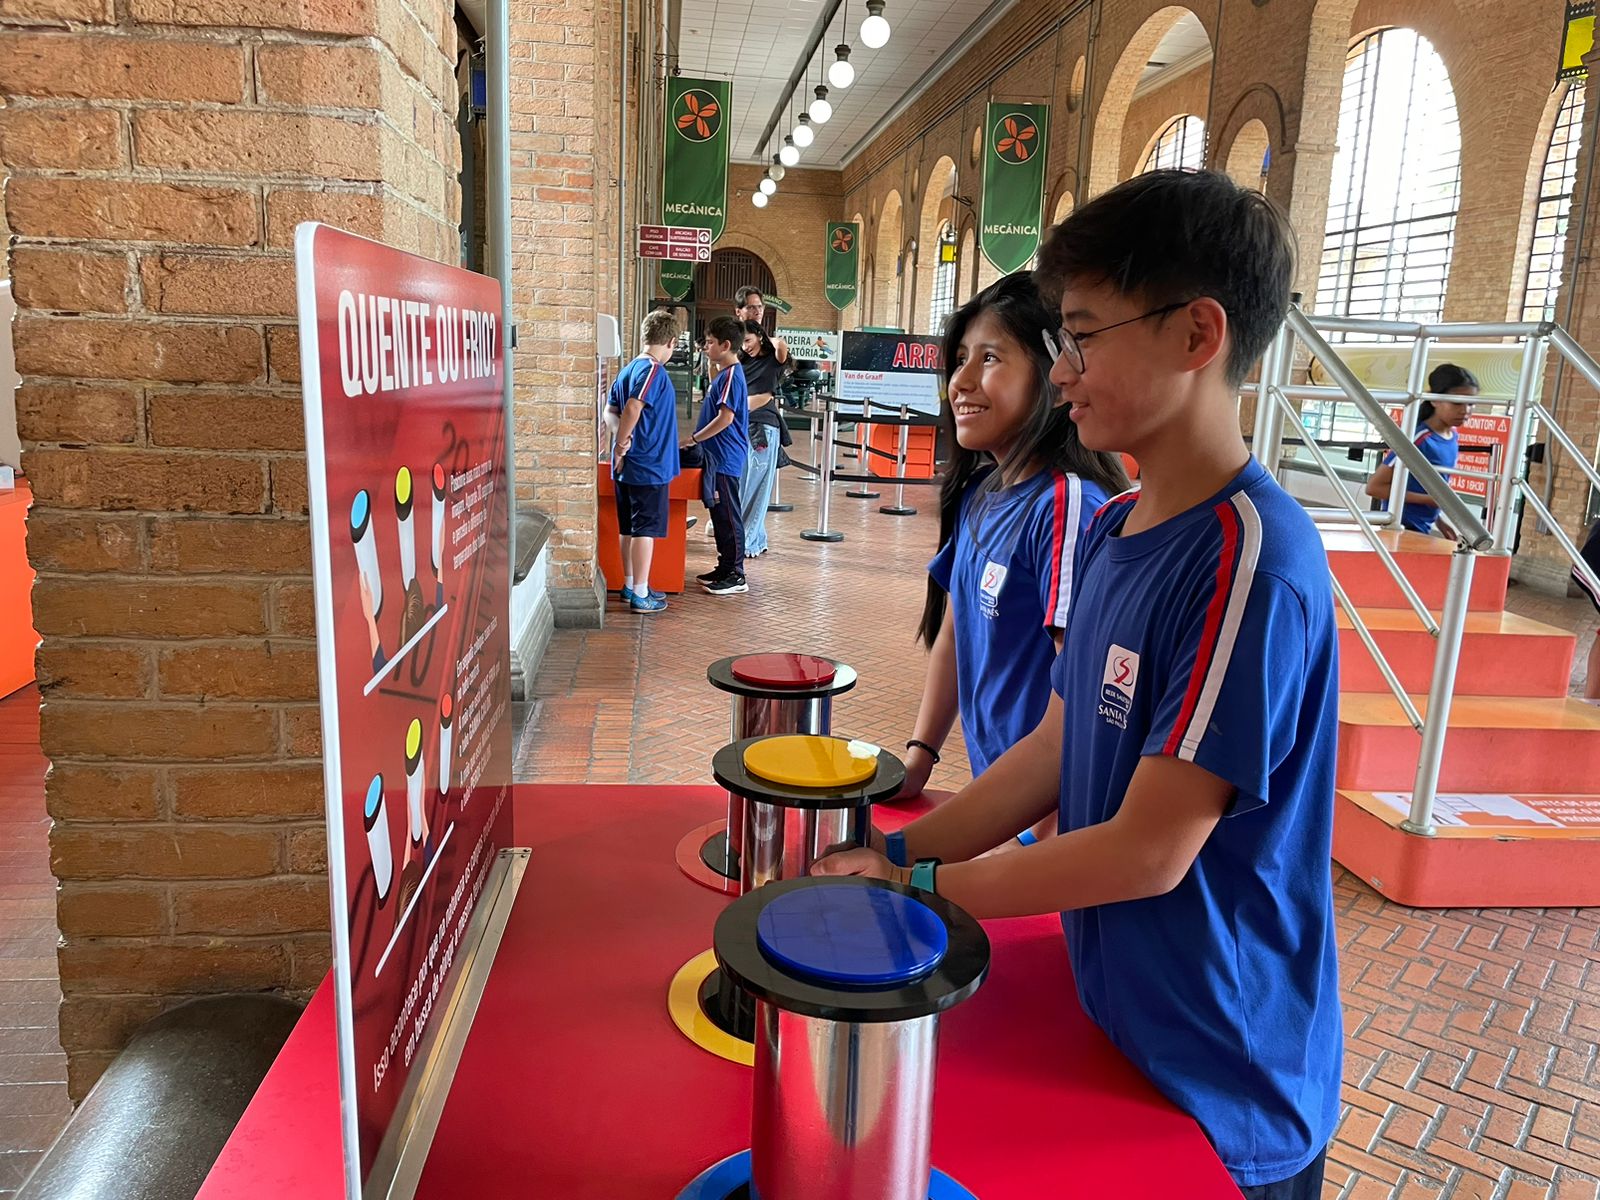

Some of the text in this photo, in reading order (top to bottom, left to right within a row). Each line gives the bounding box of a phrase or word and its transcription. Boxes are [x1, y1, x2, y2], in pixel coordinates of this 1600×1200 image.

[665, 203, 722, 216] MECÂNICA
[984, 222, 1038, 236] MECÂNICA
[826, 282, 856, 290] MECÂNICA
[338, 289, 496, 398] QUENTE OU FRIO?
[779, 336, 811, 346] ADEIRA
[844, 371, 856, 380] Van
[856, 372, 864, 380] de
[374, 1046, 389, 1093] Isso
[390, 980, 418, 1055] acontece
[418, 955, 428, 996] por
[429, 934, 438, 967] que
[439, 918, 446, 943] na
[446, 875, 464, 927] natureza
[465, 862, 470, 884] os
[470, 834, 483, 871] corpos
[405, 1033, 415, 1067] em
[415, 992, 432, 1042] busca
[432, 973, 439, 1000] de
[439, 934, 454, 983] atingir
[458, 893, 473, 937] mesma
